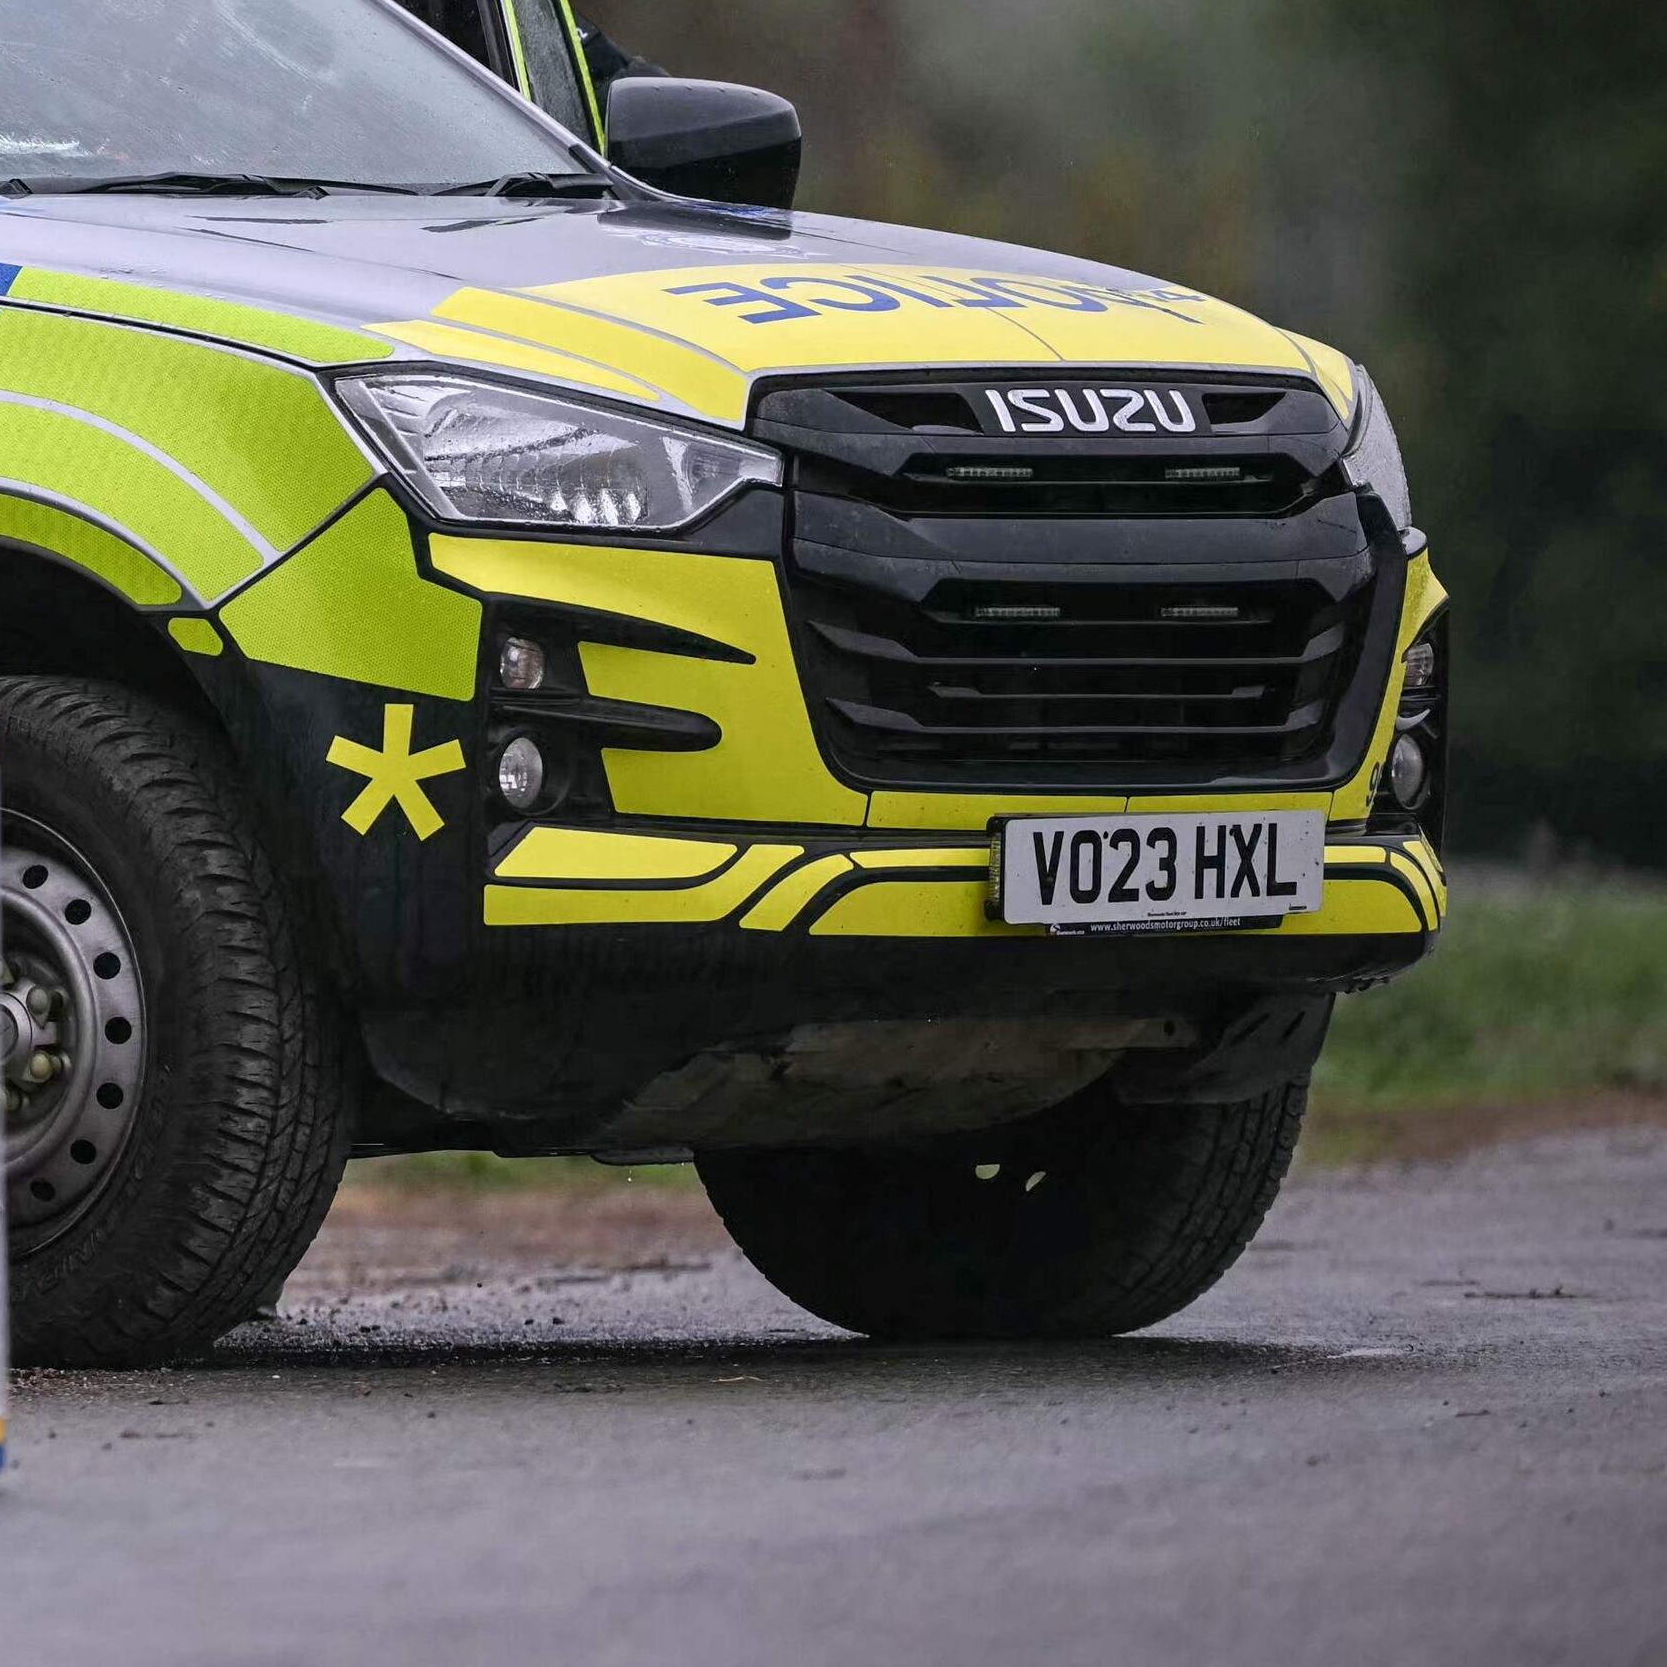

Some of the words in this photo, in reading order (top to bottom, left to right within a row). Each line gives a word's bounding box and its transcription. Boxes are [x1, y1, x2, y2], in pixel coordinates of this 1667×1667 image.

[985, 389, 1196, 431] ISUZU
[1032, 826, 1178, 906] VO23
[1194, 822, 1297, 900] HXL
[1090, 917, 1241, 931] www.sherwoodsmotorgroup.co.uk/fleet
